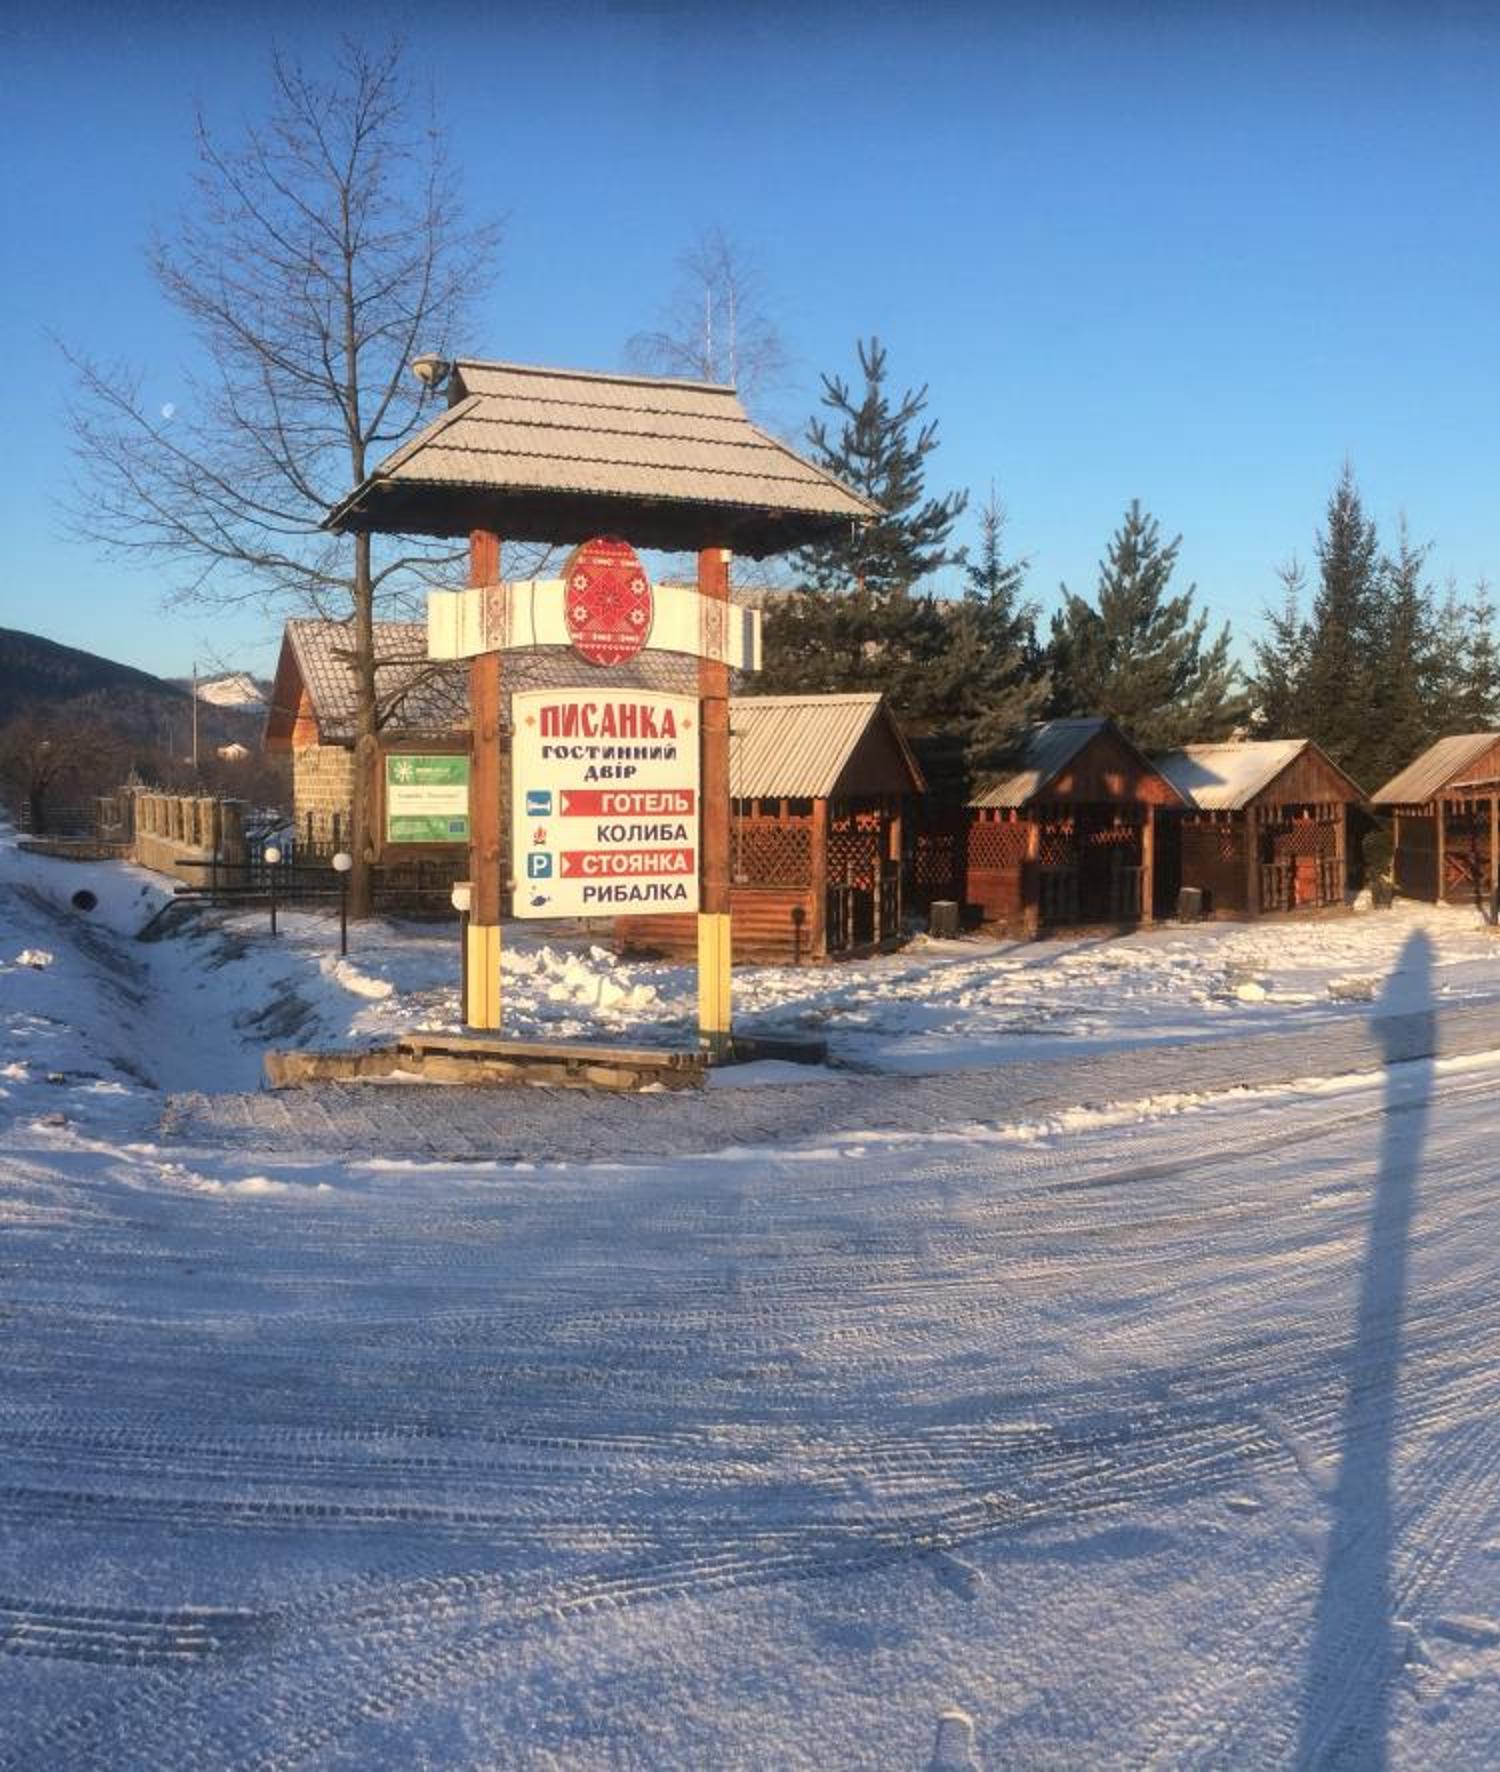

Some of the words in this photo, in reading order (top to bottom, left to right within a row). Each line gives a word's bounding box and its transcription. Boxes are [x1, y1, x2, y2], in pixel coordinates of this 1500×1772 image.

[540, 703, 677, 739] ПИСАНКА
[542, 743, 677, 760] ГОСТИННИЙ
[584, 762, 637, 782] ДВІР
[601, 793, 689, 813] ГОТЕЛЬ
[597, 824, 688, 842] КОЛИБА
[581, 853, 688, 873] СТОЯНКА
[583, 883, 687, 903] РИБАЛКА
